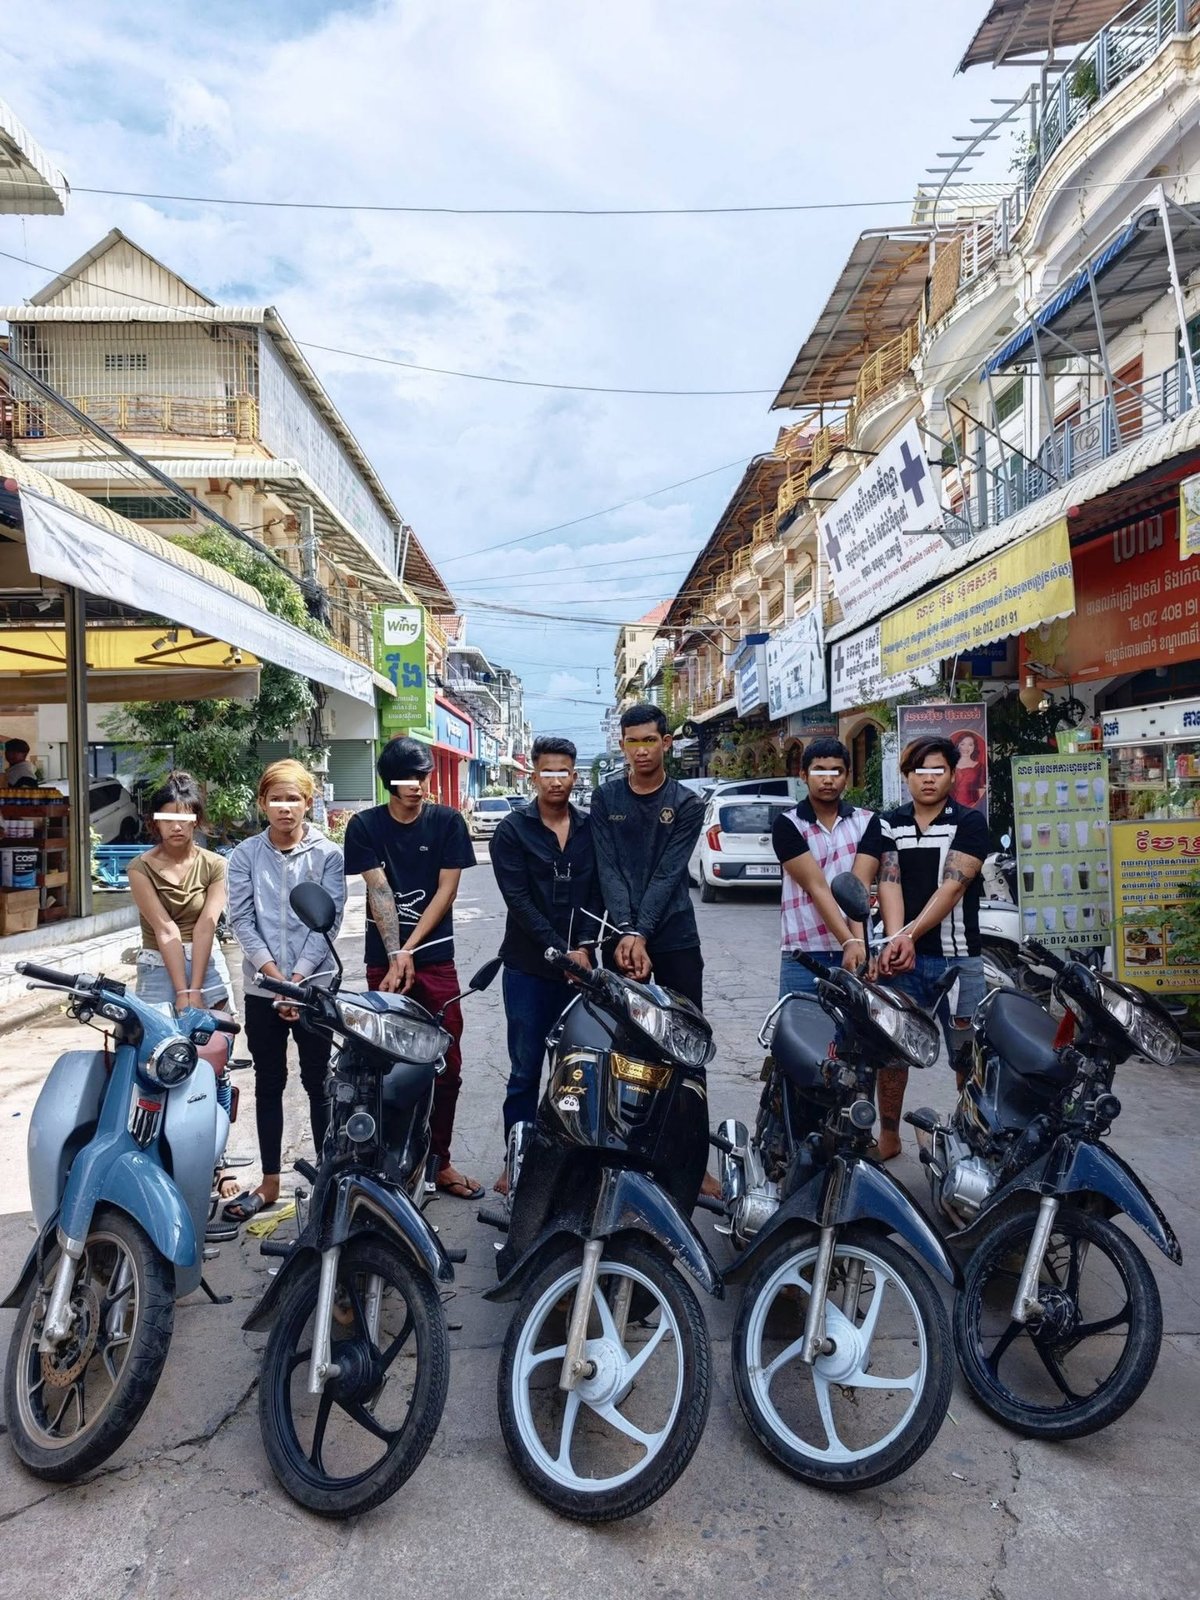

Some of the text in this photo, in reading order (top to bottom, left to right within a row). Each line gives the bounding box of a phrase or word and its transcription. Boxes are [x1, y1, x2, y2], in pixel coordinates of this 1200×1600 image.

[983, 621, 993, 633] 012
[1009, 610, 1018, 624] 91
[1143, 611, 1158, 628] 012
[1161, 603, 1182, 623] 408
[1185, 598, 1199, 616] 191
[387, 618, 418, 635] Wing
[1050, 936, 1067, 945] 012
[1068, 935, 1079, 944] 40
[1081, 934, 1090, 943] 81
[1092, 933, 1103, 942] 91
[625, 1085, 651, 1095] HONDA
